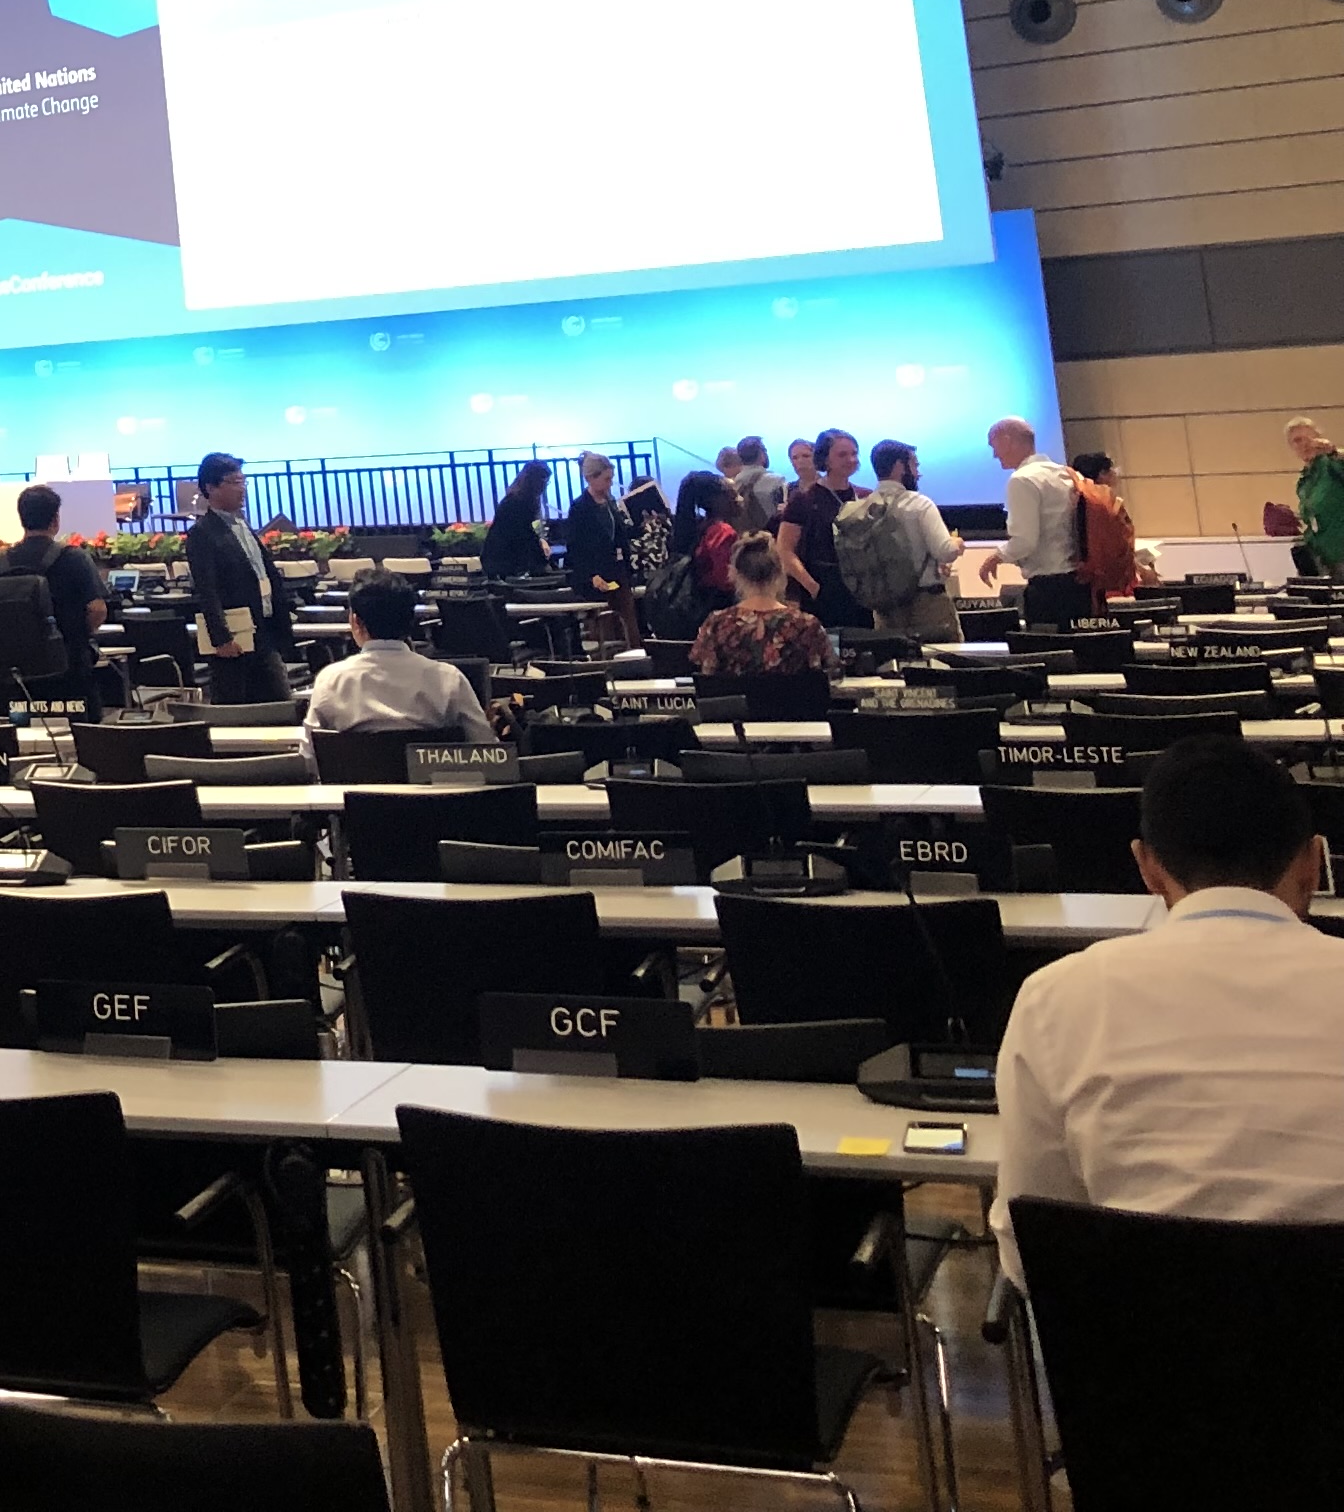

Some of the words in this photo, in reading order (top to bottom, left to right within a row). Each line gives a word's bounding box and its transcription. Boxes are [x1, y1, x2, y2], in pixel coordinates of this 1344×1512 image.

[34, 66, 97, 90] Nations
[41, 94, 100, 116] Change
[955, 598, 1004, 609] GUYANA
[1070, 617, 1121, 630] LIBERIA
[1170, 645, 1198, 659] NEW
[1203, 645, 1261, 659] ZEALAND
[612, 696, 649, 710] SAINT
[657, 696, 696, 710] LUCIA
[415, 747, 508, 764] THAILAND
[997, 745, 1125, 764] TIMOR-LESTE
[147, 835, 212, 855] CIFOR
[566, 839, 665, 860] COMIFAC
[900, 840, 968, 863] EBRD
[93, 992, 151, 1021] GEF
[550, 1006, 620, 1037] GCF
